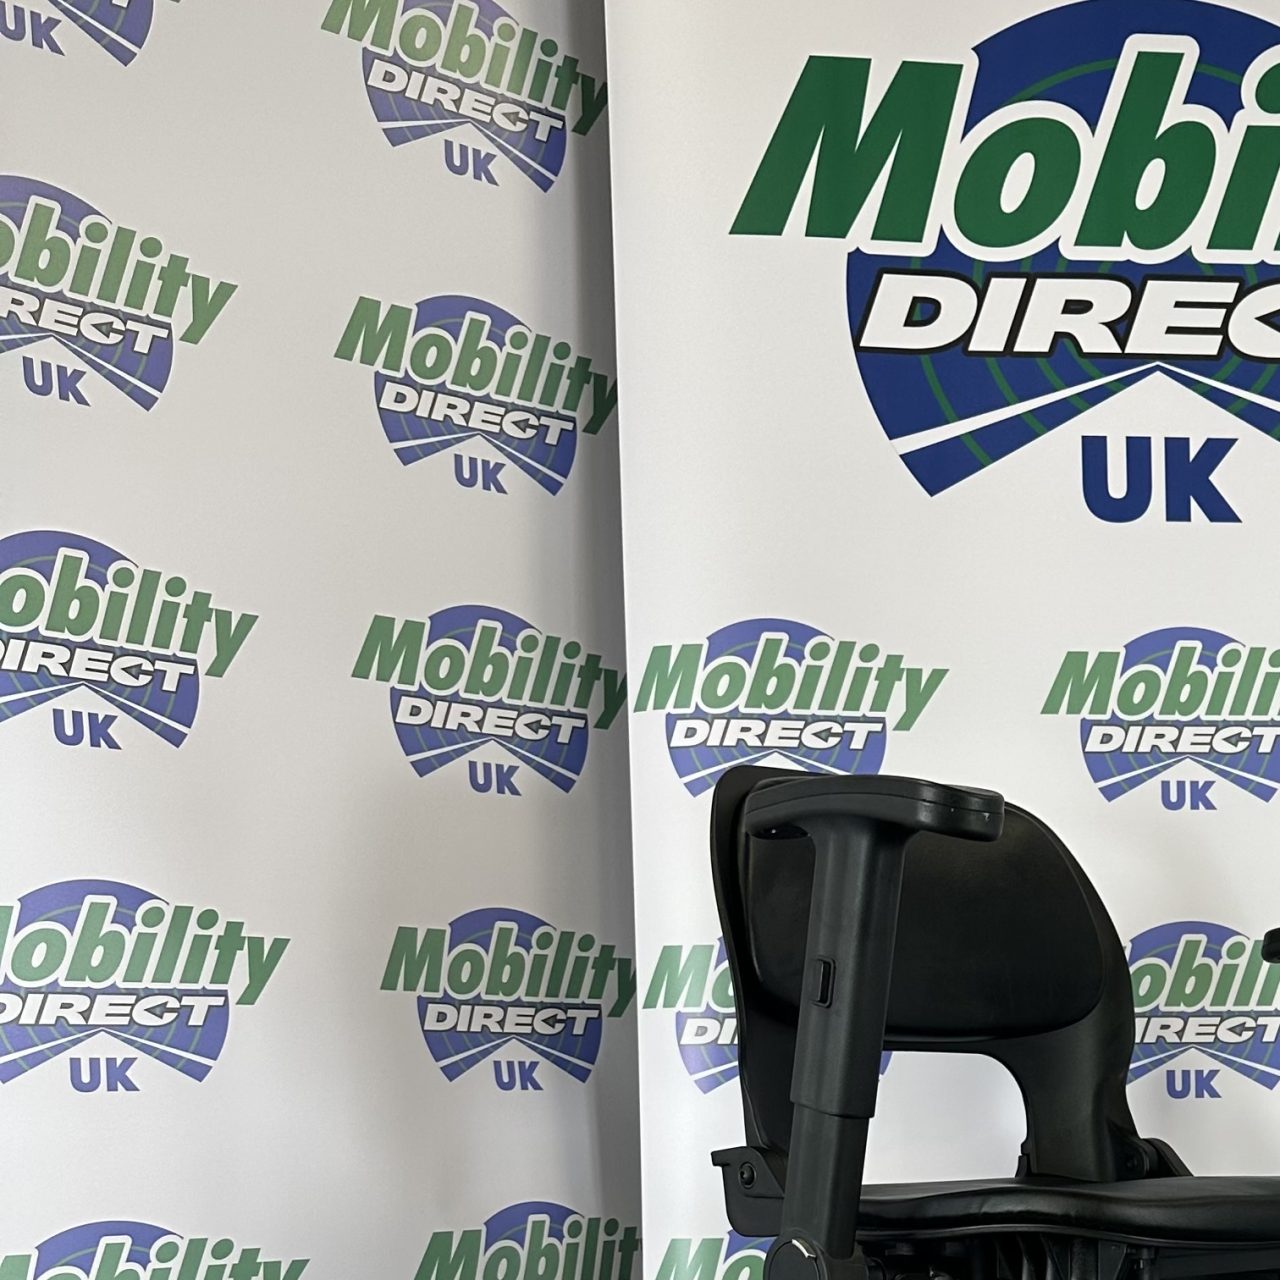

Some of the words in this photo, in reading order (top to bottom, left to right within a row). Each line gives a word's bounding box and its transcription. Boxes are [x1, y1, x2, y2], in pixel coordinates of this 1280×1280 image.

[0, 1, 65, 56] UK
[321, 0, 608, 136] Mobility
[368, 59, 563, 142] DIRECT
[444, 139, 499, 186] UK
[0, 203, 238, 345] bility
[0, 286, 169, 354] RECT
[22, 356, 91, 407] UK
[334, 296, 618, 435] Mobility
[379, 381, 573, 446] DIRECT
[454, 453, 508, 495] UK
[1081, 435, 1243, 523] UK
[0, 554, 259, 678] obility
[0, 638, 196, 693] IRECT
[351, 614, 627, 730] Mobility
[633, 638, 950, 732] Mobility
[53, 708, 122, 750] UK
[395, 695, 586, 744] DIRECT
[669, 718, 883, 751] DIRECT
[468, 760, 522, 796] UK
[1160, 780, 1218, 811] UK
[0, 902, 291, 1005] obility
[380, 926, 637, 1018] Mobility
[423, 1003, 600, 1036] DIRECT
[69, 1057, 140, 1092] UK
[493, 1060, 544, 1091] UK
[1166, 1070, 1222, 1099] UK
